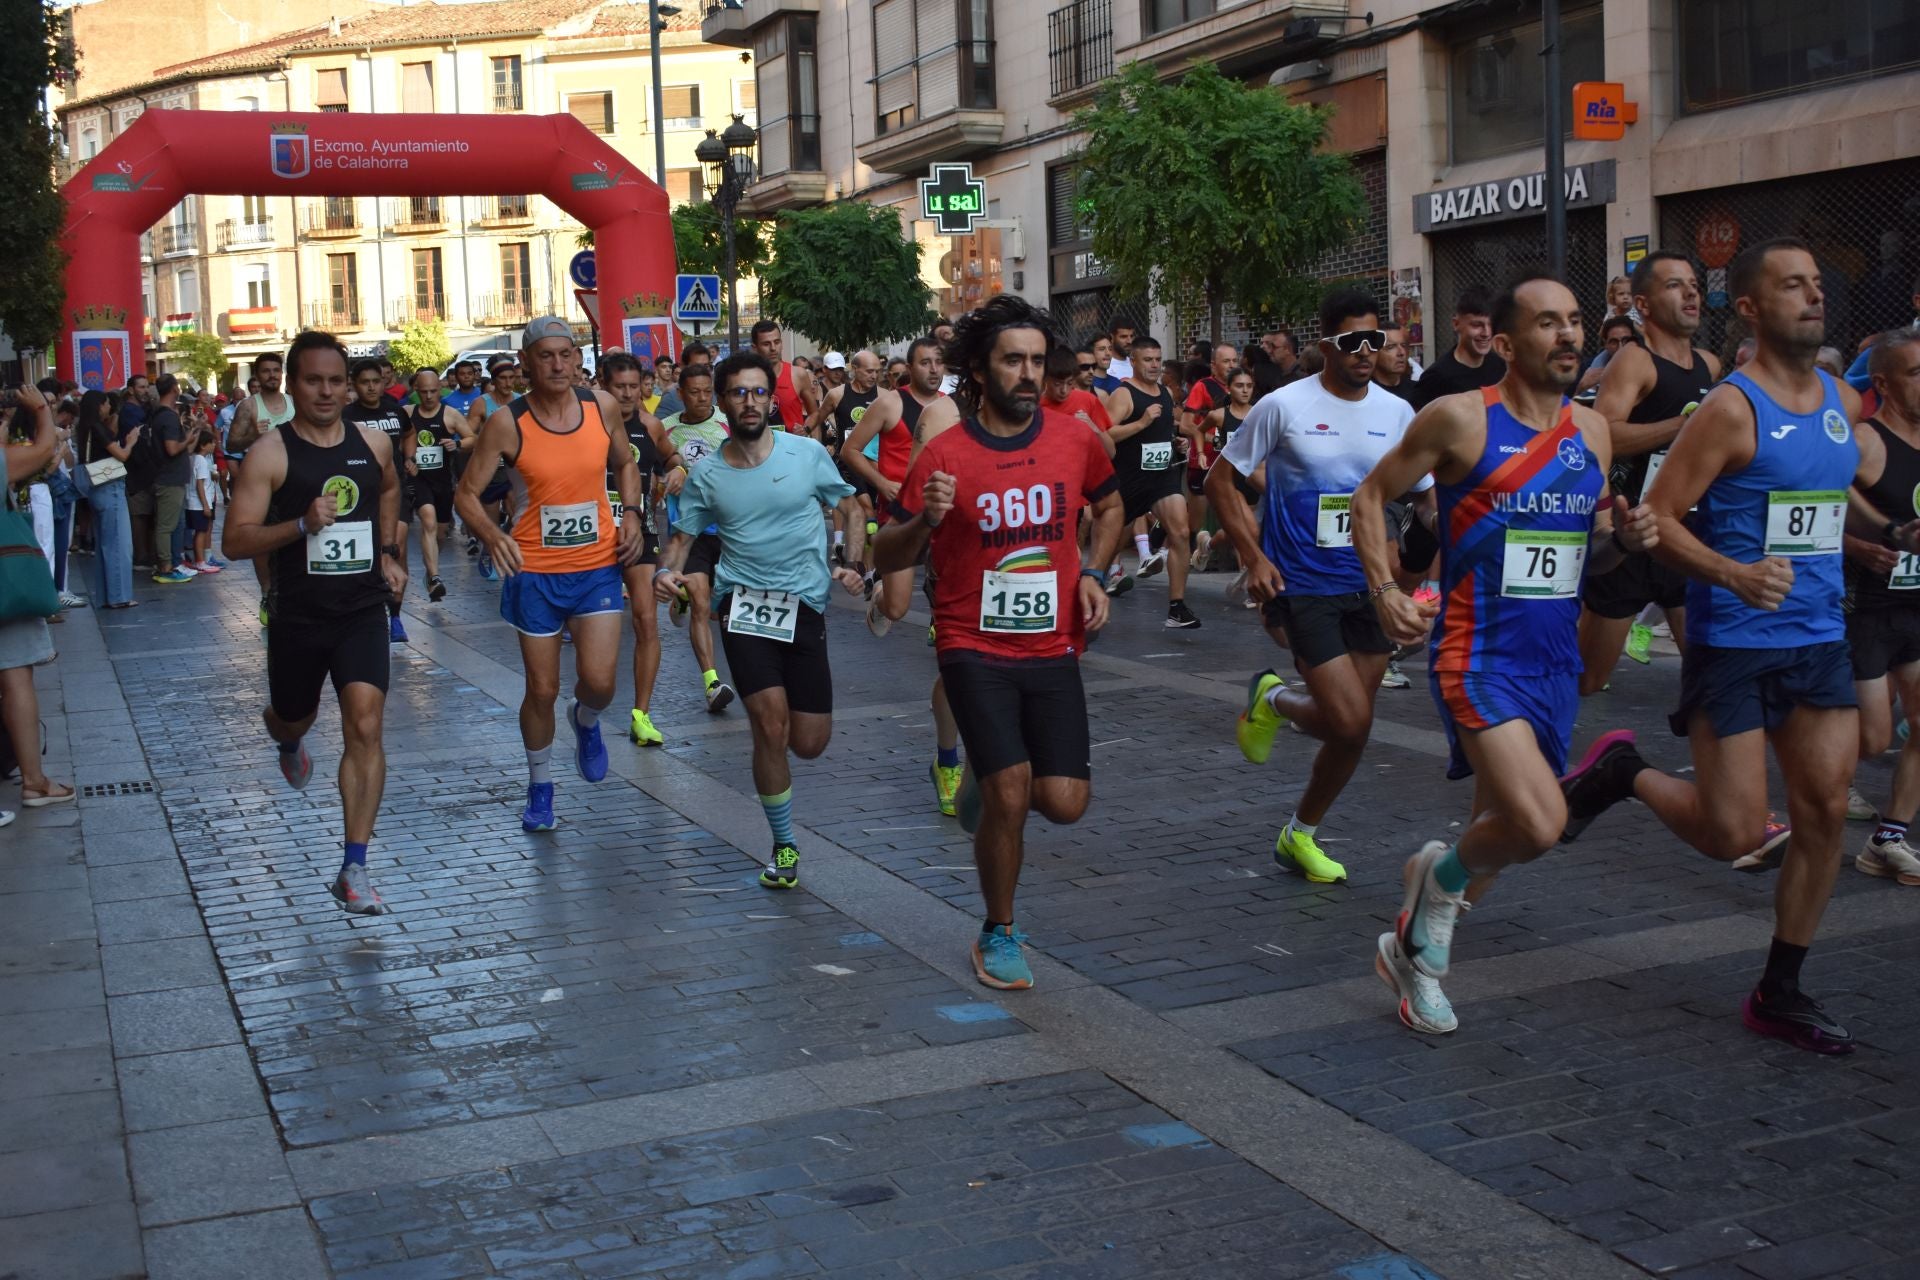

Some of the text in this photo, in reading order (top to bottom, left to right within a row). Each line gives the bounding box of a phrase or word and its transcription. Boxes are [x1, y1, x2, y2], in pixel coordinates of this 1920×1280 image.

[1586, 97, 1616, 117] Ria
[314, 139, 469, 155] Excmo. Ayuntamiento
[314, 156, 408, 168] de Calahorra
[1430, 167, 1589, 224] BAZAR OUA
[421, 454, 437, 464] 67
[1146, 451, 1169, 463] 242
[976, 484, 1052, 532] 360
[1490, 492, 1538, 513] VILLA
[1542, 493, 1562, 513] DE
[548, 515, 592, 537] 226
[1788, 506, 1817, 536] 87
[982, 522, 1065, 549] RUNNERS
[324, 538, 356, 561] 31
[1526, 547, 1557, 578] 76
[737, 602, 790, 627] 267
[992, 591, 1051, 616] 158
